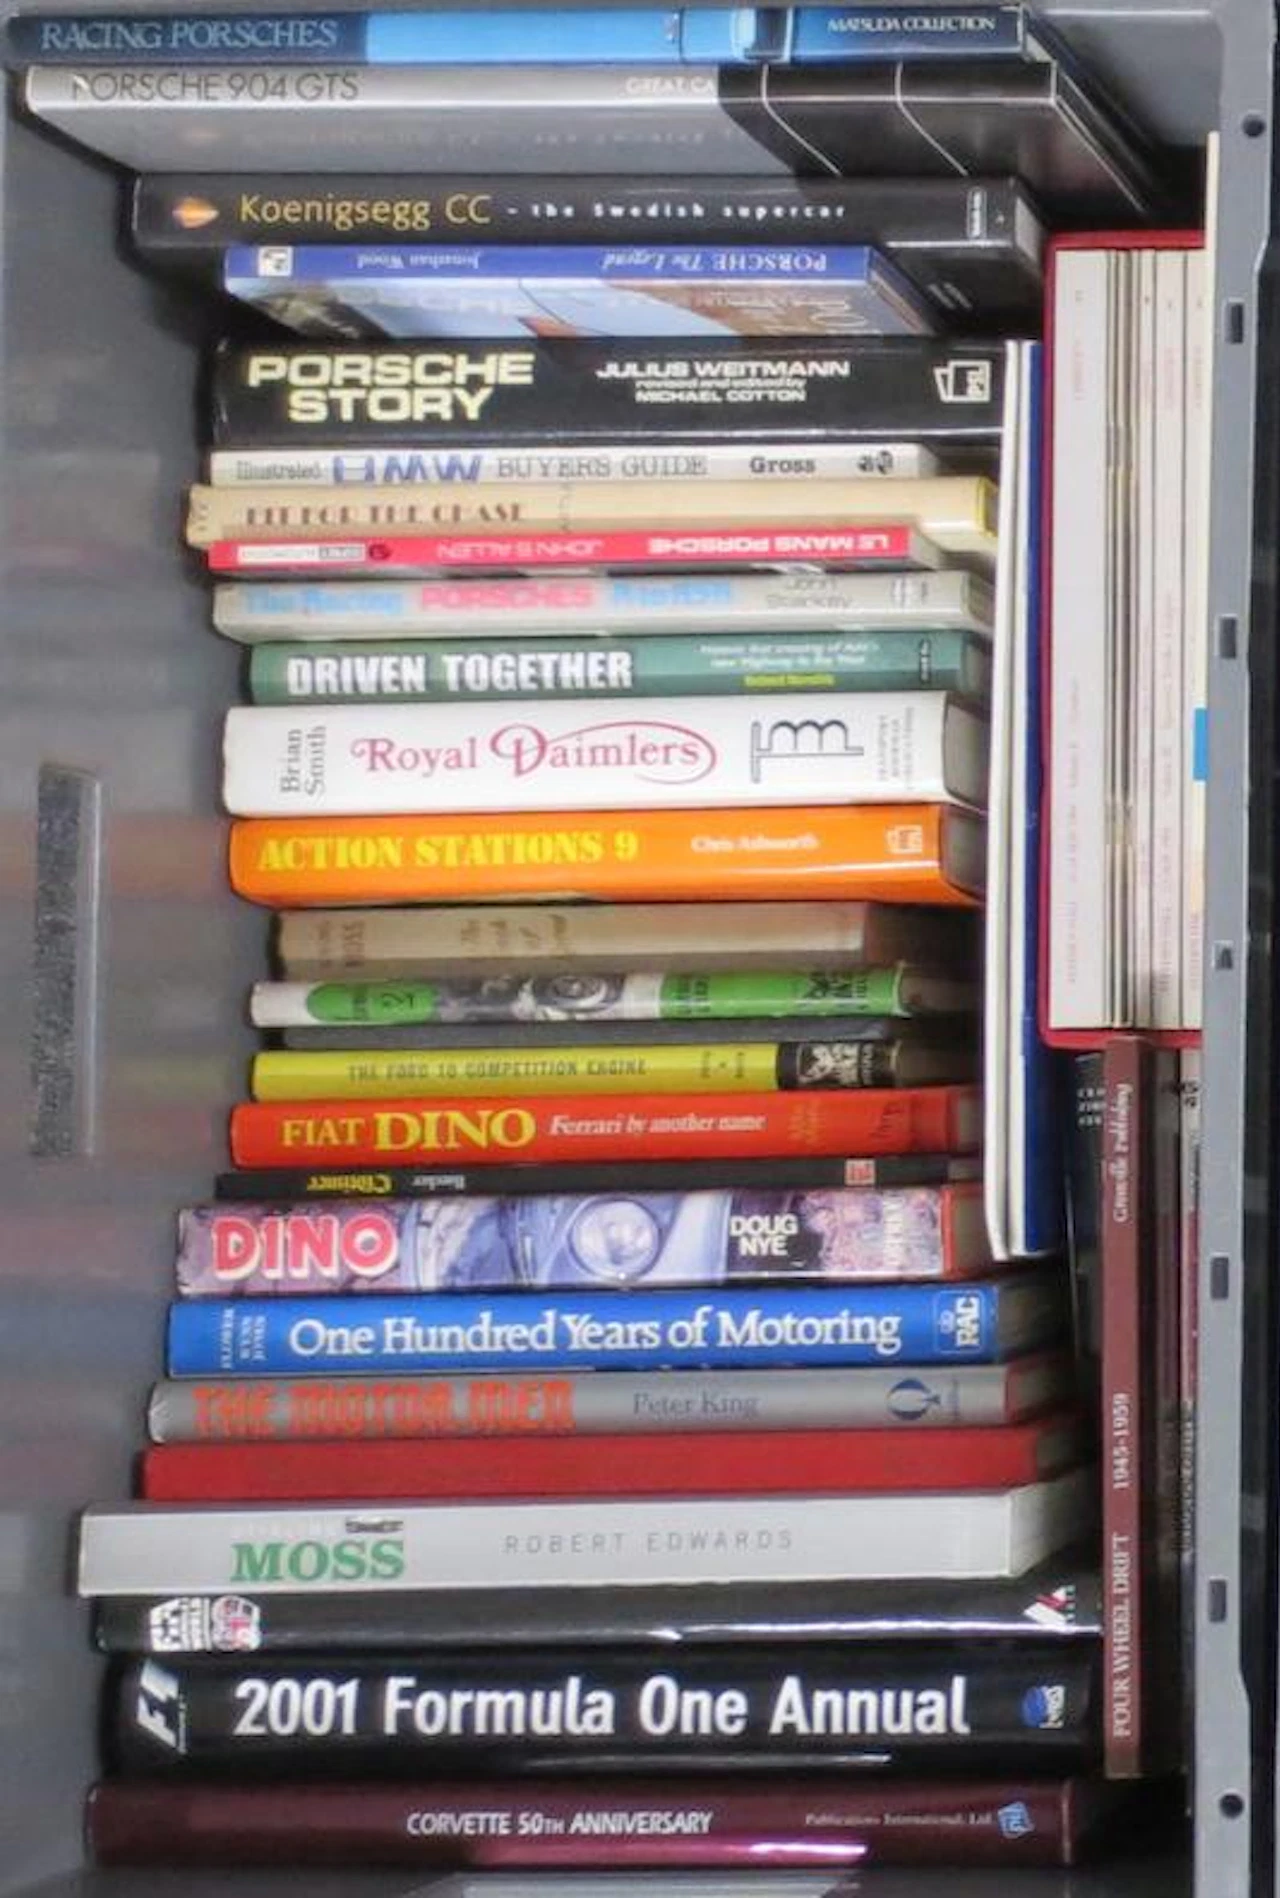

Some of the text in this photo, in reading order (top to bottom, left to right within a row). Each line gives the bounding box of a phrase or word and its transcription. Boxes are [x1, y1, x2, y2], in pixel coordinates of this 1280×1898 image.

[41, 18, 338, 51] RACING PORSCHES
[828, 17, 995, 32] MATSUDA COLLECTION
[240, 193, 431, 229] Koenigsegg
[445, 193, 492, 224] CC
[595, 201, 704, 218] Swedish
[723, 204, 846, 221] supercar
[249, 354, 535, 386] PORSCHE
[597, 361, 849, 379] JULIUS WEITMANN
[288, 389, 495, 422] STORY
[635, 390, 805, 403] MICHAEL COTTON
[750, 456, 815, 474] Gross
[287, 652, 633, 695] DRIVEN TOGETHER
[281, 729, 303, 793] Brian
[305, 725, 326, 797] Smith
[260, 833, 638, 873] ACTION STATIONS 9
[691, 838, 734, 853] Chris
[282, 1109, 537, 1151] FIAT DINO
[550, 1114, 766, 1135] Ferrari by another name
[730, 1216, 798, 1236] DOUG
[212, 1215, 398, 1280] DINO
[740, 1237, 788, 1256] NYE
[634, 1393, 757, 1417] Peter King
[503, 1531, 793, 1555] ROBERT EDWARDS
[231, 1541, 405, 1583] MOSS
[1112, 1393, 1133, 1738] FOUR WHEEL DRIFT 1945-1959
[233, 1675, 971, 1736] 2001 Formula One Annual
[407, 1811, 713, 1835] CORVETTE 50TH ANNIVERSARY
